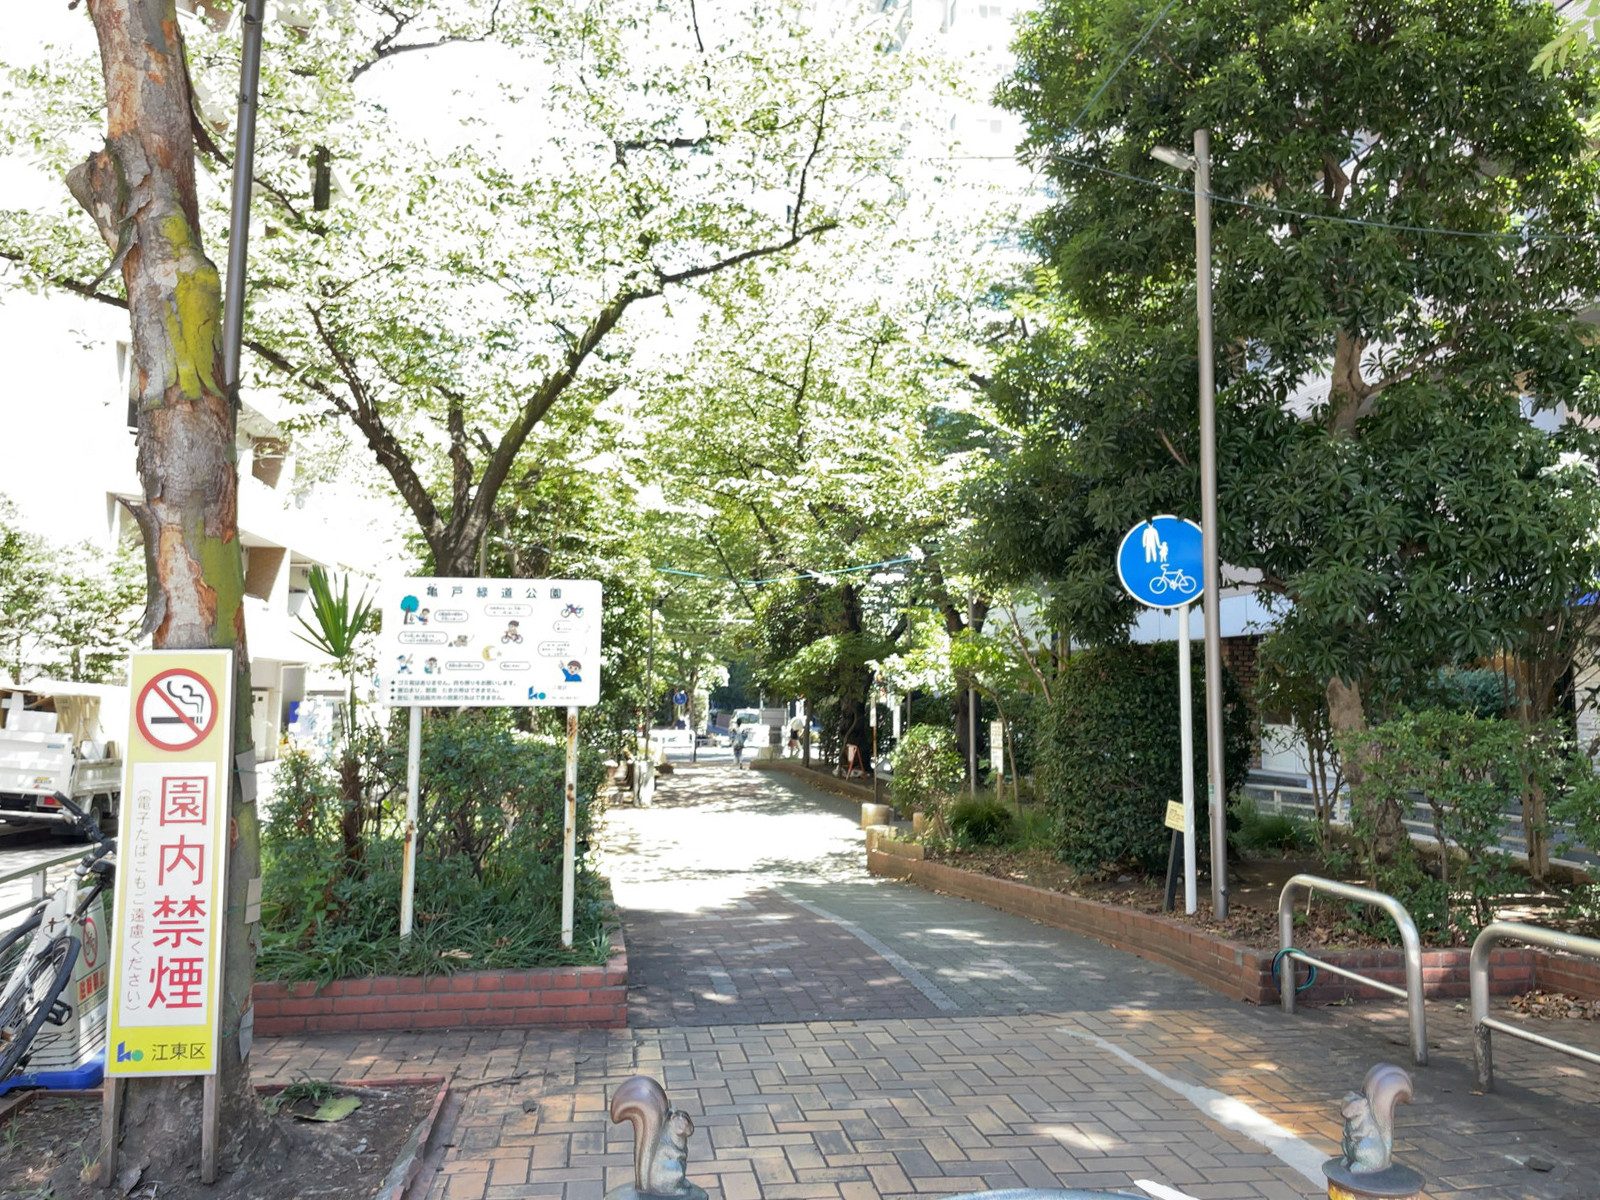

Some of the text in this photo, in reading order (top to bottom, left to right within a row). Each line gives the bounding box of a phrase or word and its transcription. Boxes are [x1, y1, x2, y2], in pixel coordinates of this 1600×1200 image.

[426, 583, 562, 600] 亀戸緑道公園
[147, 776, 209, 1010] 園内禁煙
[151, 1042, 206, 1061] 江東区
